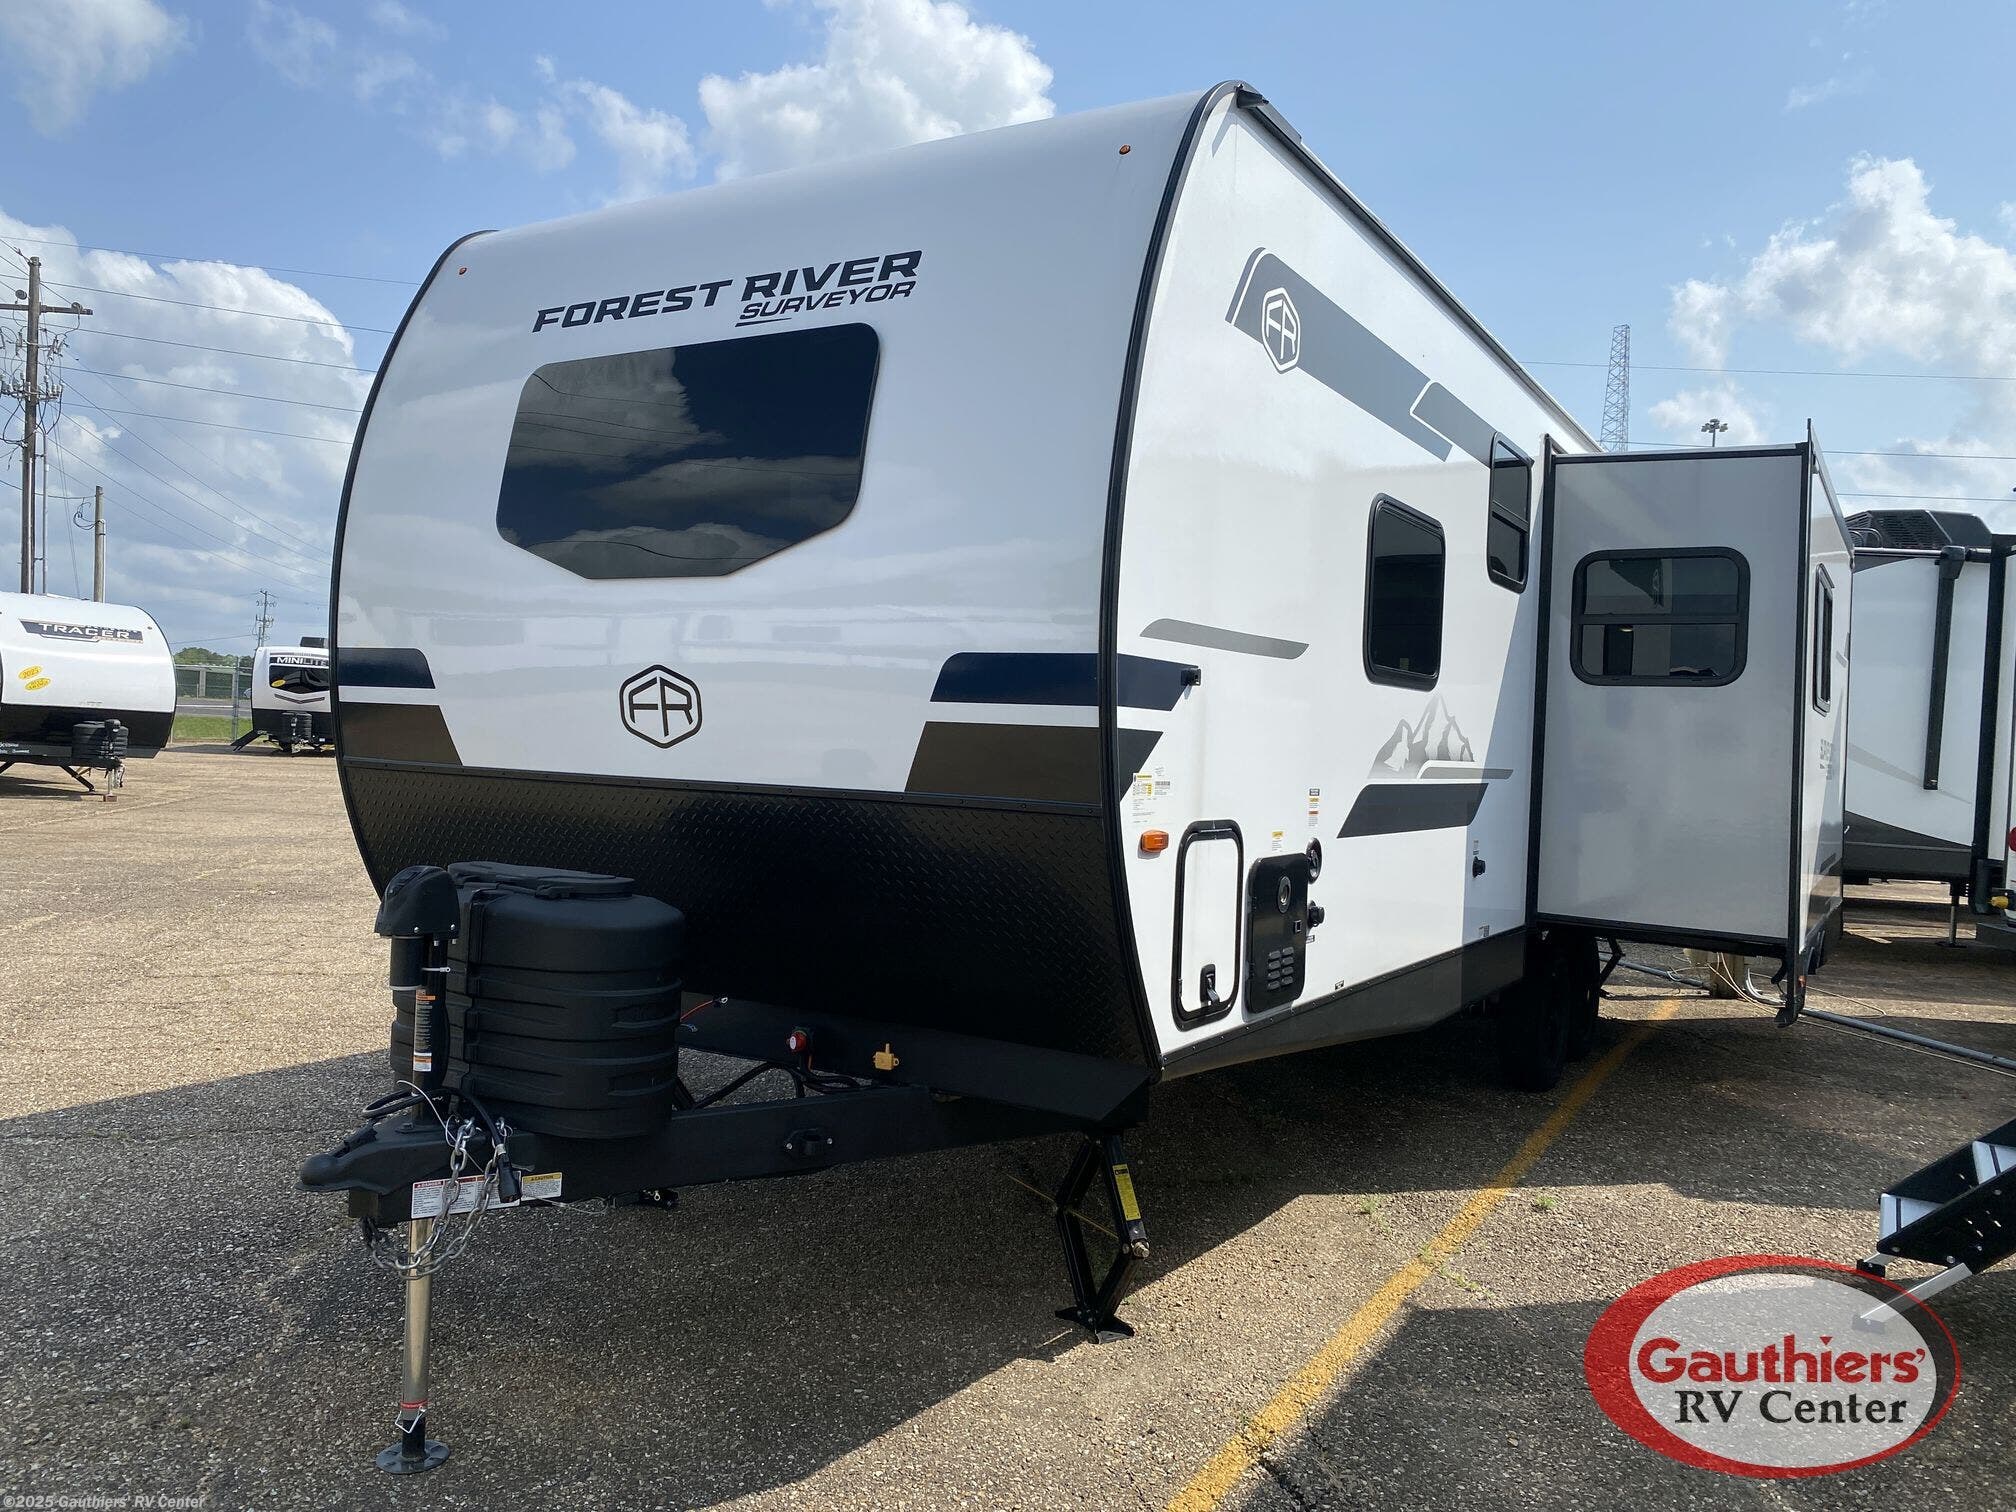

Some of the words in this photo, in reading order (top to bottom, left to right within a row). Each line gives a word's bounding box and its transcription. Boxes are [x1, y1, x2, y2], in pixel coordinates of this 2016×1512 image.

[533, 278, 733, 333] FOREST
[741, 249, 923, 302] RIVER
[738, 280, 917, 321] SURVEYOR
[37, 623, 130, 639] TRACER
[276, 656, 328, 667] MINILITE
